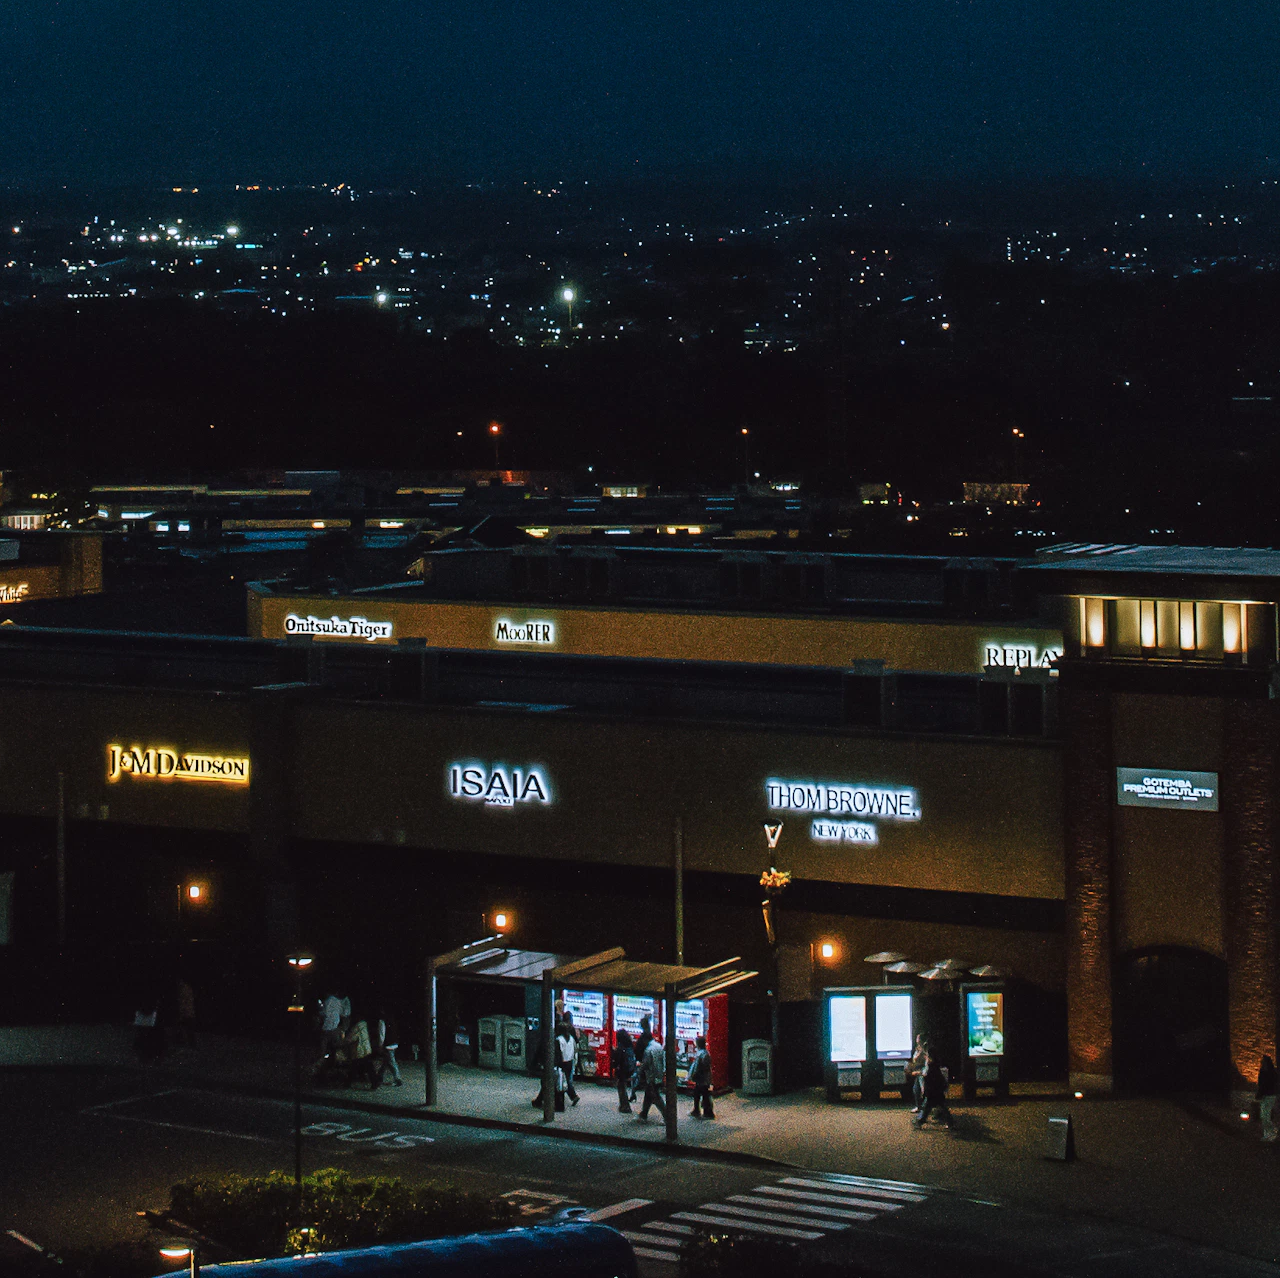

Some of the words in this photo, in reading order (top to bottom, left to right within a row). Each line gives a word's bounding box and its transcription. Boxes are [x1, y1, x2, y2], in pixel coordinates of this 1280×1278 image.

[285, 618, 347, 633] Onitsuka
[349, 620, 388, 639] Tiger
[451, 768, 547, 800] ISAIA
[1123, 783, 1168, 795] PREMIUM
[1143, 777, 1192, 789] GOTEMBA
[766, 784, 821, 810] THOM
[813, 823, 839, 837] NEW
[842, 825, 872, 840] YORK
[293, 1121, 435, 1149] BUS
